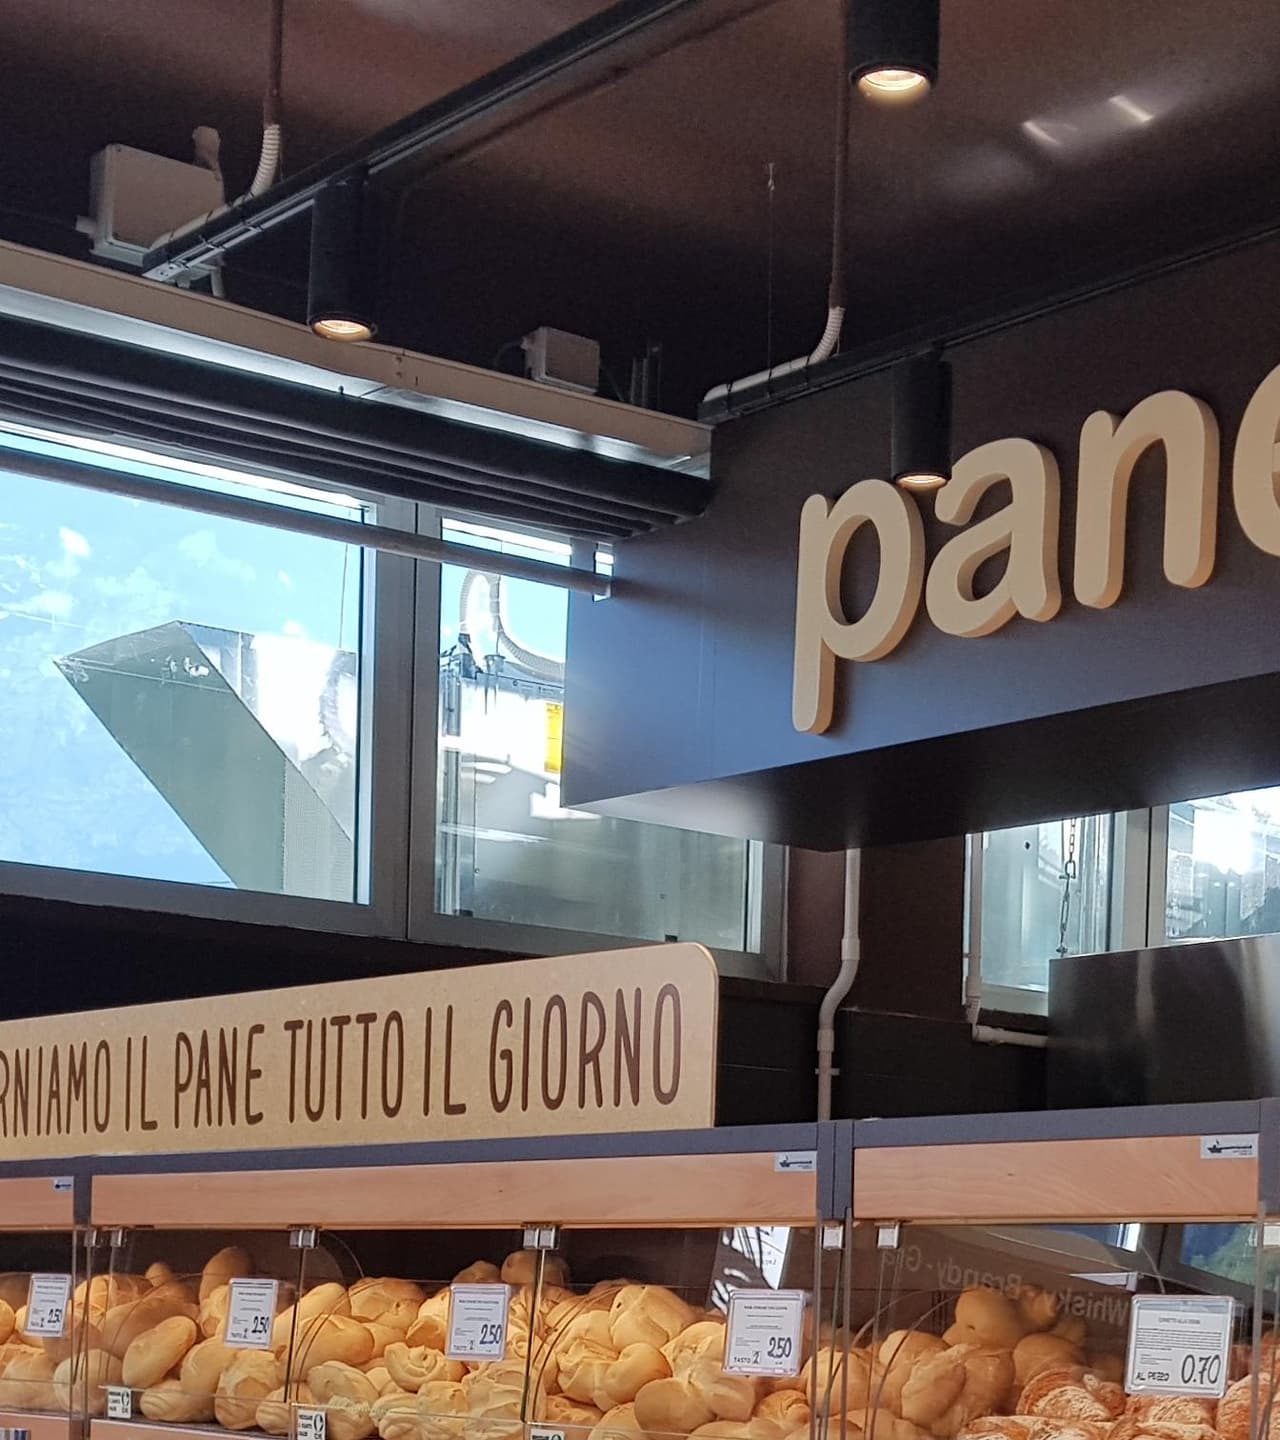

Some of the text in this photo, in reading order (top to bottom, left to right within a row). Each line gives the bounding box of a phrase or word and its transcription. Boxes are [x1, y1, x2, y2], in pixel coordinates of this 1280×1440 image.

[125, 1035, 158, 1133] IL
[174, 1024, 266, 1129] PANE
[284, 1009, 407, 1120] TUTTO
[423, 1003, 466, 1116] IL
[489, 983, 683, 1112] GIORNO
[1181, 1354, 1221, 1385] 0.70
